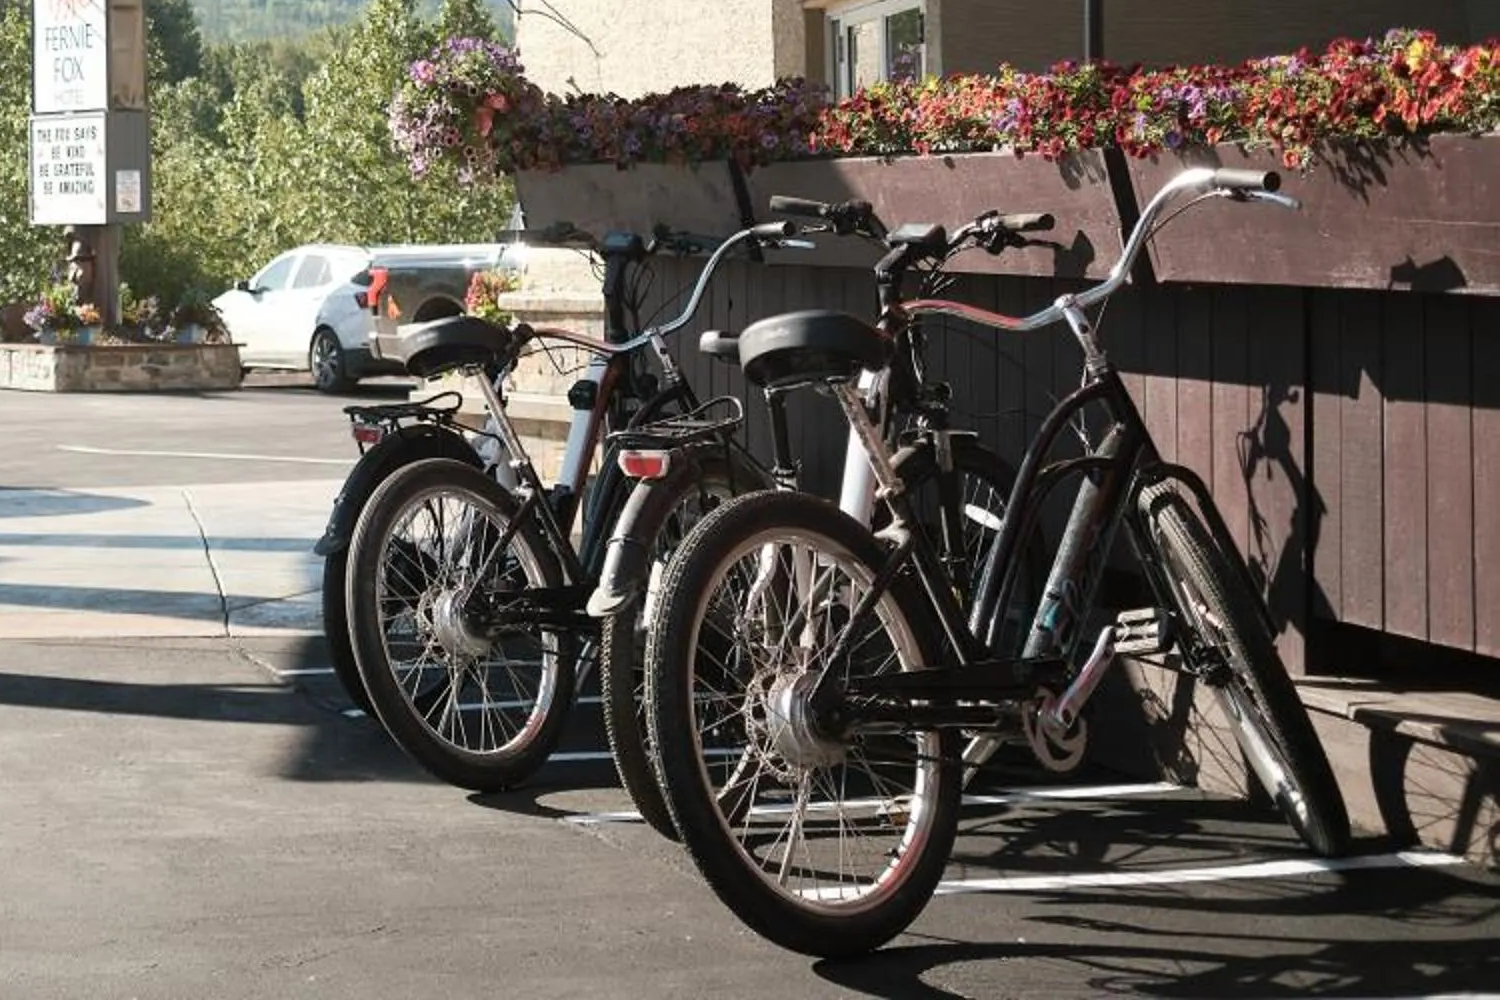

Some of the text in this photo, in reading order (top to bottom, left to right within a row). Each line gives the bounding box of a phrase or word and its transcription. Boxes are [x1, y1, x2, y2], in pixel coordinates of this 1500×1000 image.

[44, 23, 93, 51] FERNIE
[53, 56, 84, 83] FOX
[74, 126, 97, 142] SAYS
[53, 163, 95, 177] GRATEFUL
[59, 180, 94, 195] AMAZING
